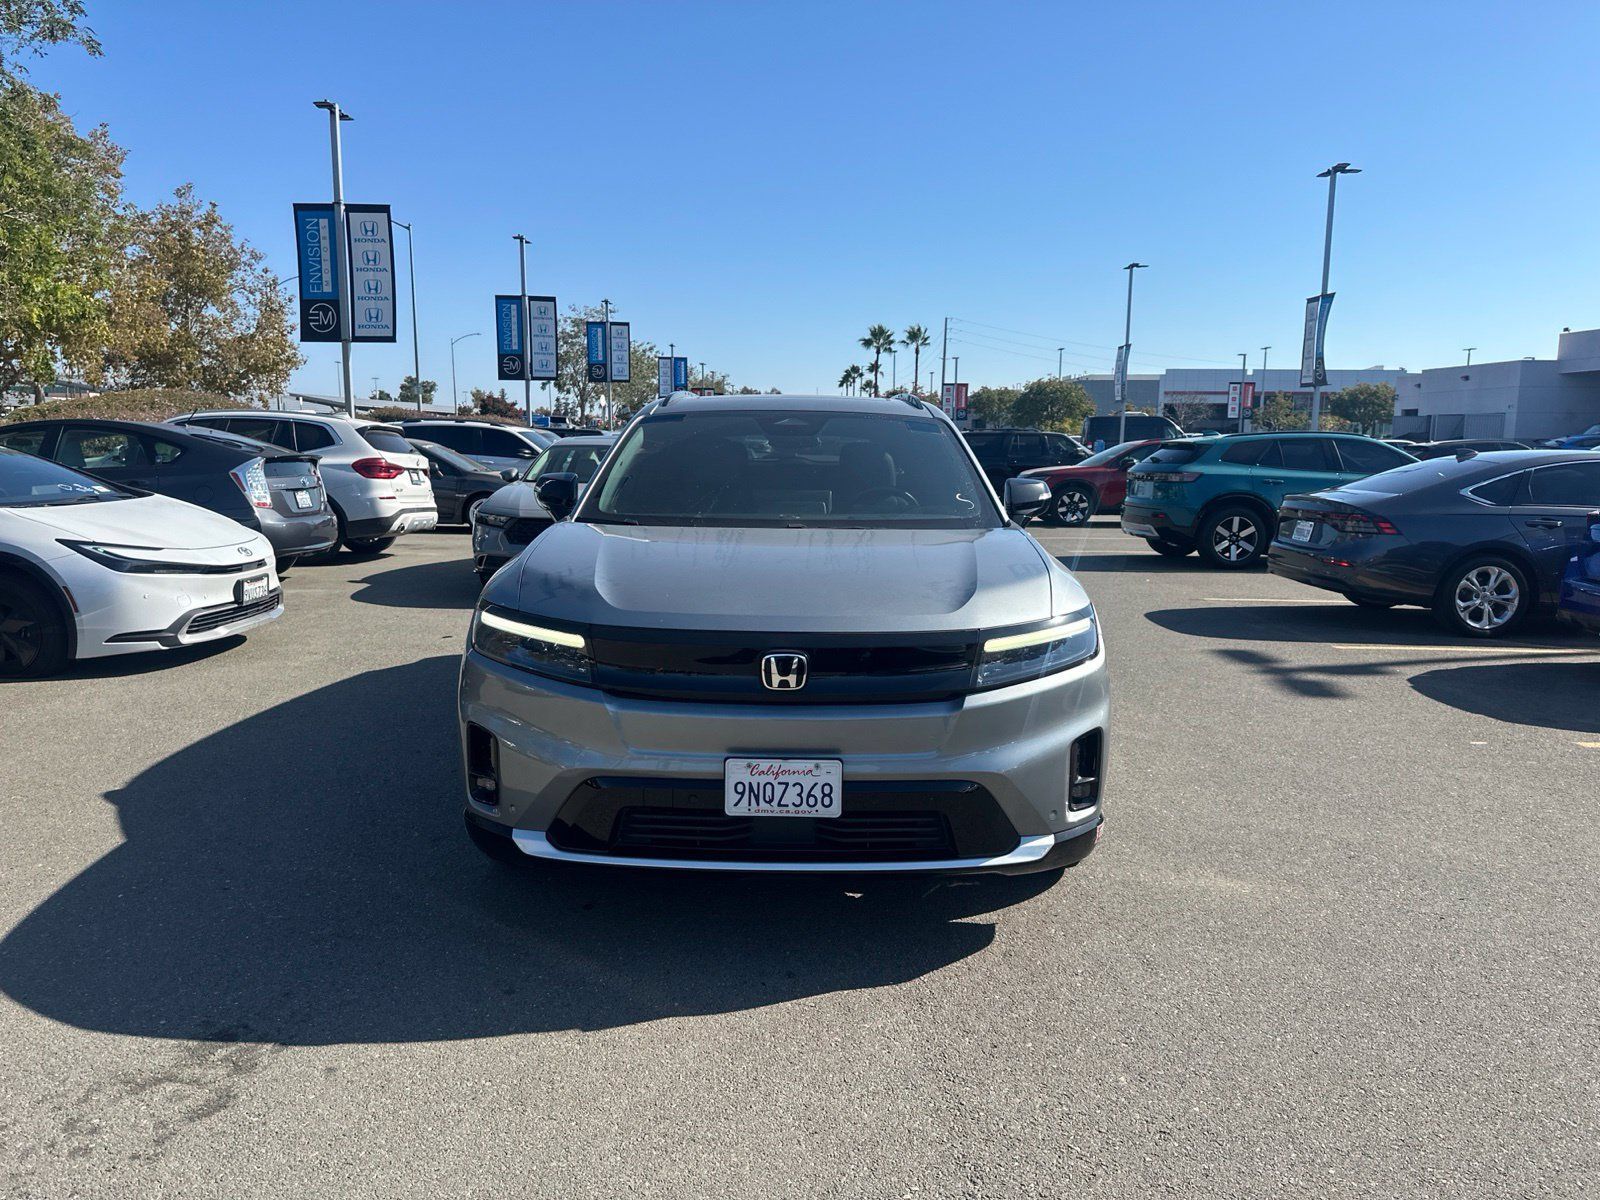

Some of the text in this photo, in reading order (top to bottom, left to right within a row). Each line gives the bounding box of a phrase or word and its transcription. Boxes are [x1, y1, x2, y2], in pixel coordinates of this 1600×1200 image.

[306, 218, 322, 293] ENVISION
[503, 303, 512, 350] ENVISION
[750, 764, 820, 780] California
[733, 781, 834, 808] 9NQZ368
